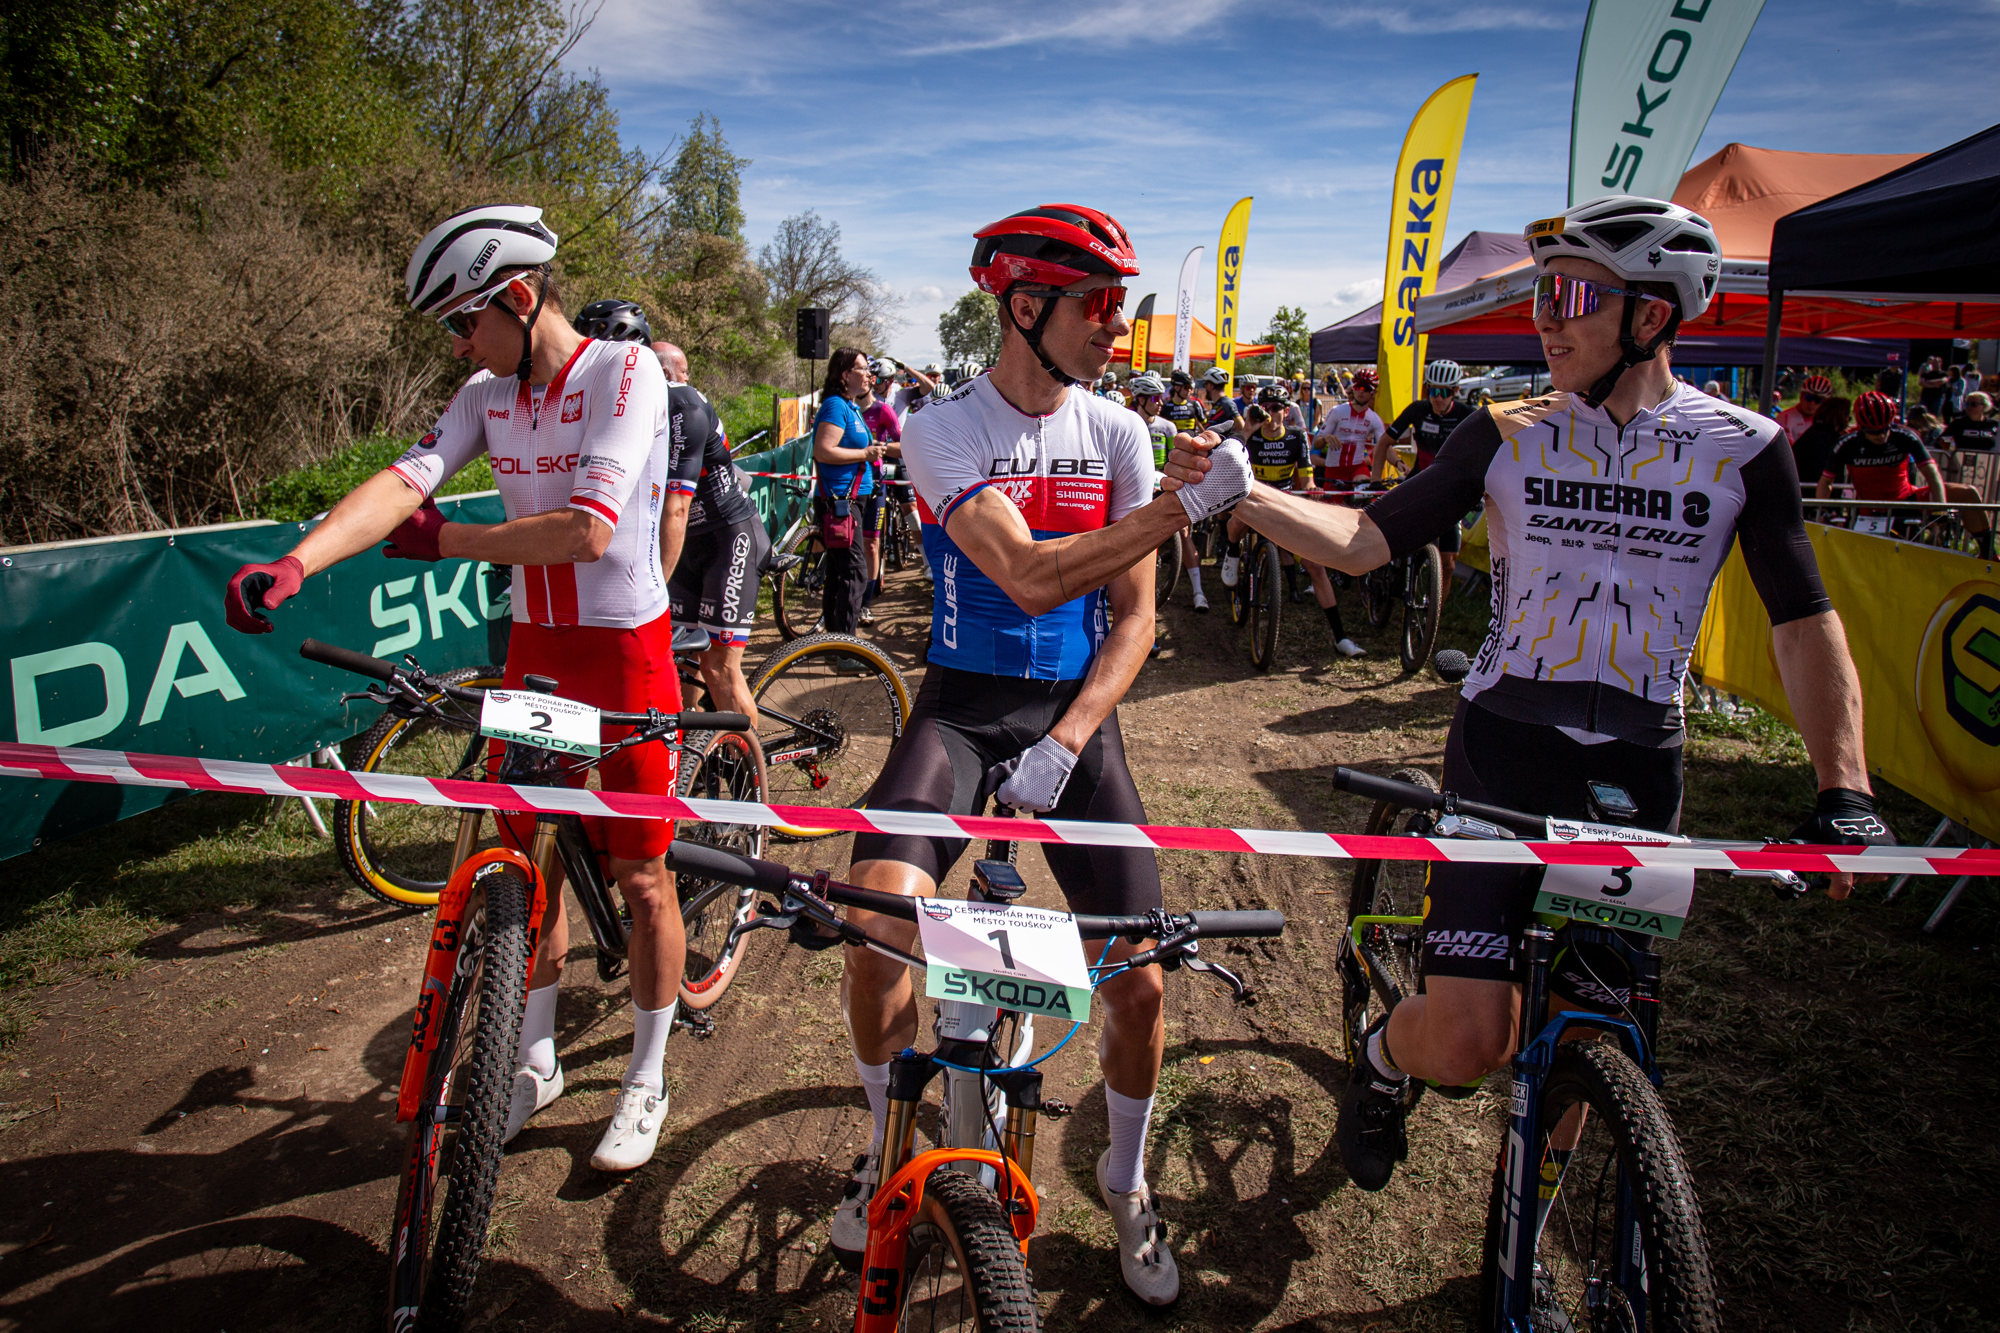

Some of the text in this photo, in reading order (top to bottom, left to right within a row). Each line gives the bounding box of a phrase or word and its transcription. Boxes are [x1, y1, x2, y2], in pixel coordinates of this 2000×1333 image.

[474, 243, 498, 277] ABUS
[1089, 241, 1123, 267] CUBE
[1393, 158, 1444, 347] sazka
[613, 346, 639, 418] POLSKA
[931, 384, 977, 407] CUBE
[989, 458, 1105, 477] CUBE
[1056, 490, 1105, 502] SHIMANO
[1208, 490, 1246, 513] CUBE
[1524, 476, 1673, 522] SUBTERRA
[1526, 513, 1707, 549] SANTA CRUZ
[1869, 522, 1878, 531] 5
[943, 552, 958, 650] CUBE
[10, 620, 247, 746] DA
[524, 701, 582, 716] MĚSTO TOUŠKOV
[537, 697, 562, 708] POHÁR
[878, 672, 902, 738] EQUATOR
[528, 711, 553, 734] 2
[774, 750, 800, 763] GOLD
[1580, 825, 1610, 836] ČESKÝ
[1611, 830, 1643, 842] POHÁR
[1600, 865, 1633, 897] 3
[954, 905, 1068, 924] ČESKÝ POHÁR MTB XCO
[973, 916, 1053, 930] MĚSTO TOUŠKOV
[987, 929, 1016, 970] 1
[1425, 930, 1509, 948] SANTA
[1434, 943, 1509, 960] CRUZ
[410, 992, 434, 1053] FOX
[1511, 1080, 1527, 1100] OCK
[862, 1266, 901, 1317] 3
